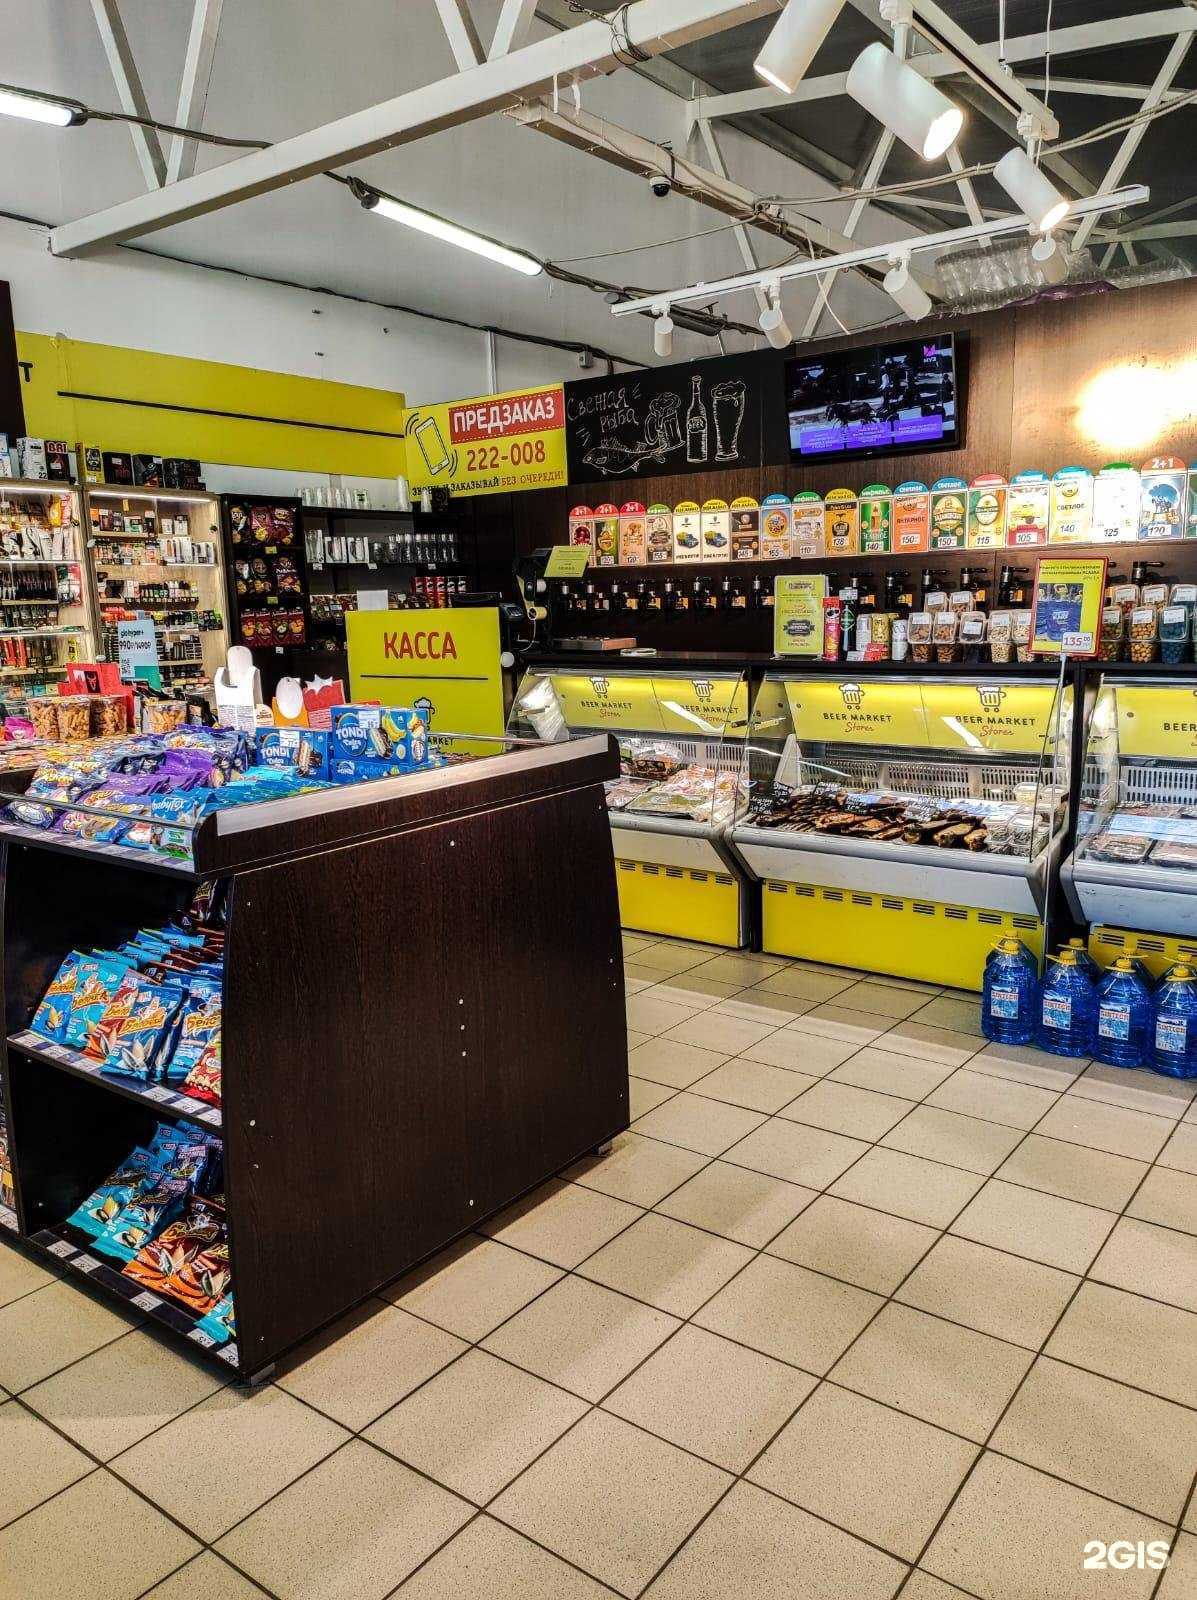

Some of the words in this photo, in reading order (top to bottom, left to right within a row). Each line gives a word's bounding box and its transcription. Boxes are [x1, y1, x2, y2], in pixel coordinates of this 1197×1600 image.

[453, 396, 556, 433] ПРЕДЗАКАЗ
[466, 440, 546, 473] 222-008
[1152, 457, 1174, 469] 2+1
[450, 476, 500, 493] ЗАКАЗЫВАЙ
[502, 477, 516, 486] БЕЗ
[520, 470, 564, 484] ОЧЕРЕДИ!
[1104, 528, 1119, 536] 125
[976, 536, 990, 544] 115
[384, 632, 458, 660] КАССА
[1064, 636, 1082, 646] 135
[602, 701, 632, 710] MARKET
[703, 706, 740, 714] MARKET
[823, 712, 848, 721] BEER
[850, 713, 892, 722] MARKET
[955, 715, 984, 725] BEER
[987, 716, 1036, 726] MARKET
[1164, 722, 1197, 731] BEER
[336, 726, 367, 740] TONDI
[260, 746, 290, 760] TONDI
